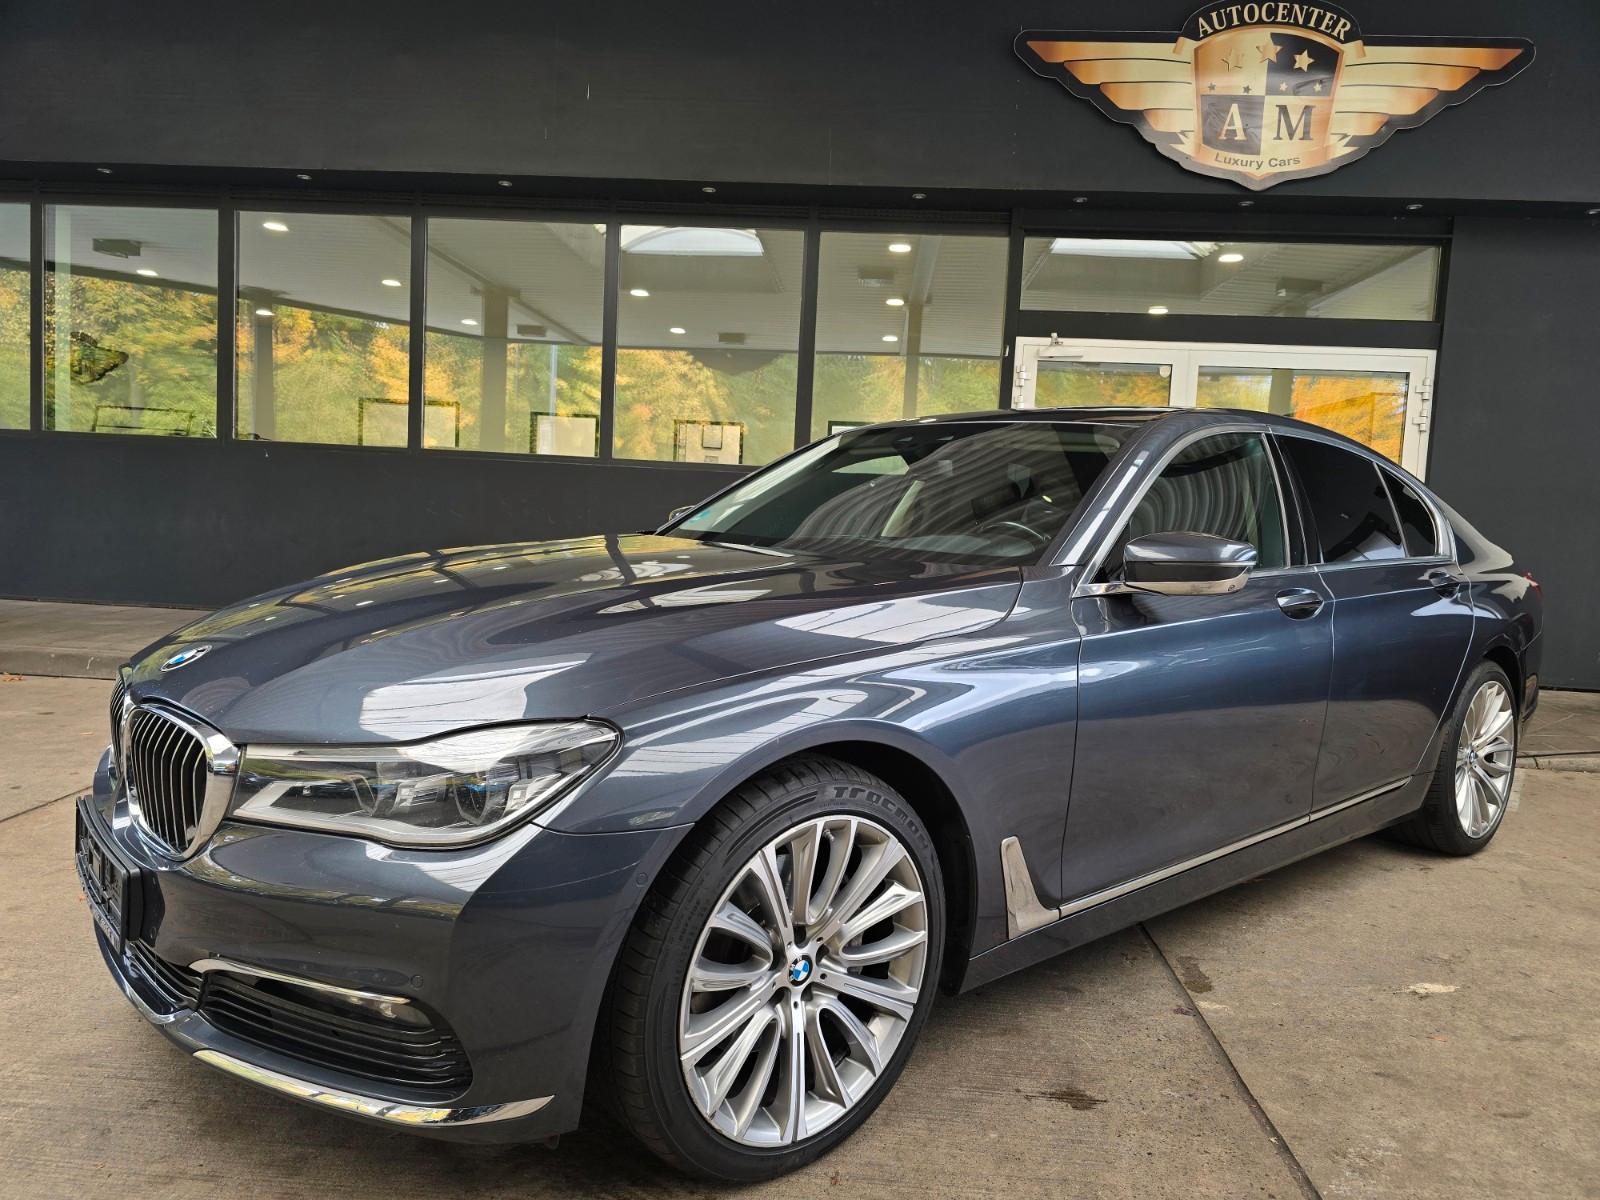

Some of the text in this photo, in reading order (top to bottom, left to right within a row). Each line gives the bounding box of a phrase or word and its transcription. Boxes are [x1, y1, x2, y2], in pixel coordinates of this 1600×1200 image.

[1198, 2, 1351, 41] AUTOCENTER
[1218, 103, 1316, 141] A M
[1214, 152, 1301, 170] Luxury Cars
